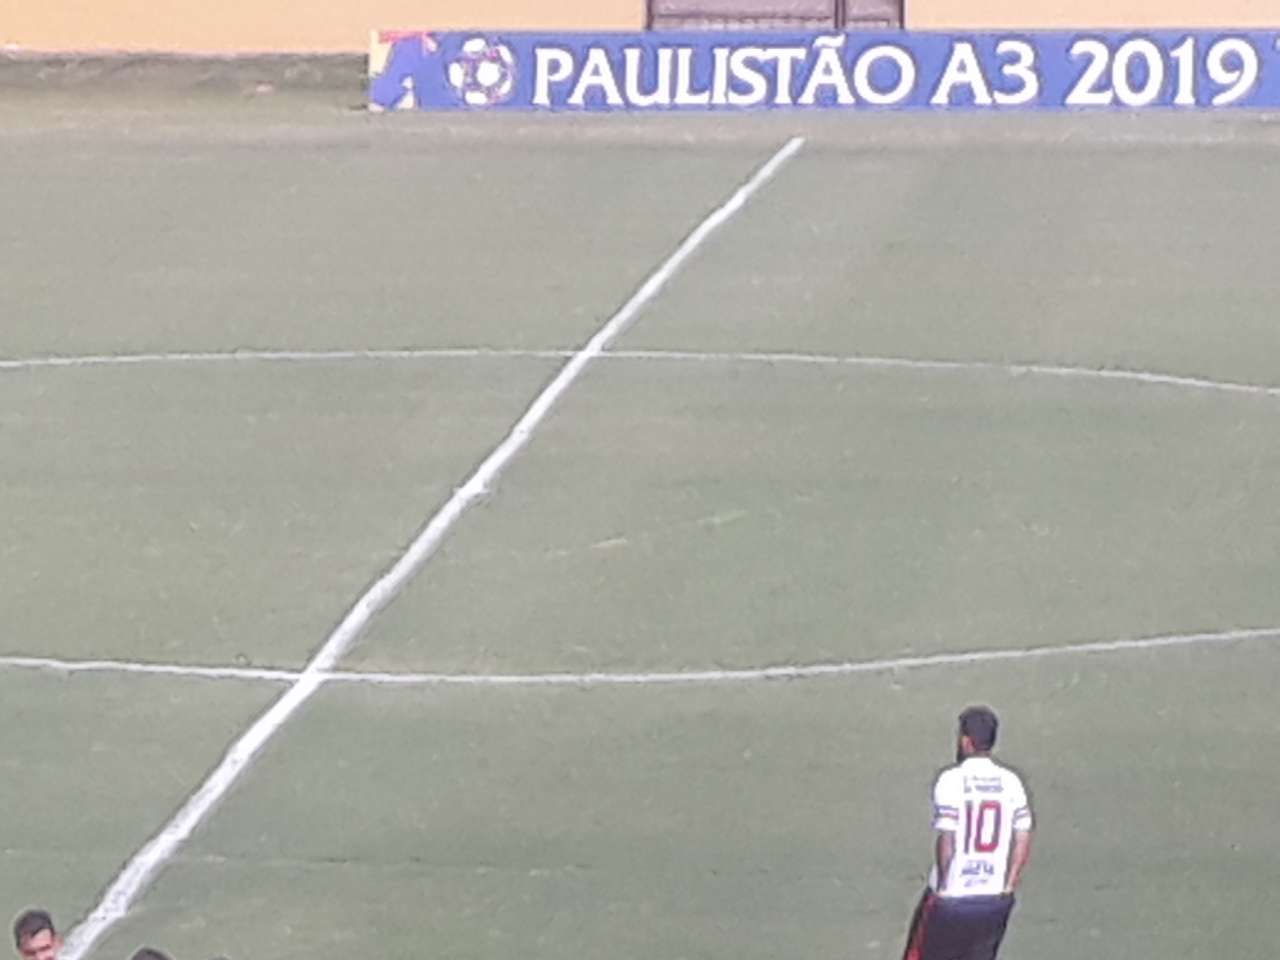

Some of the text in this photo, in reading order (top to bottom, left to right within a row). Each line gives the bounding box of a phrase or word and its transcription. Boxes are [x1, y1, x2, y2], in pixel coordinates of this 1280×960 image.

[531, 33, 1259, 107] PAULISTÃO A3 2019
[963, 799, 1002, 853] 10
